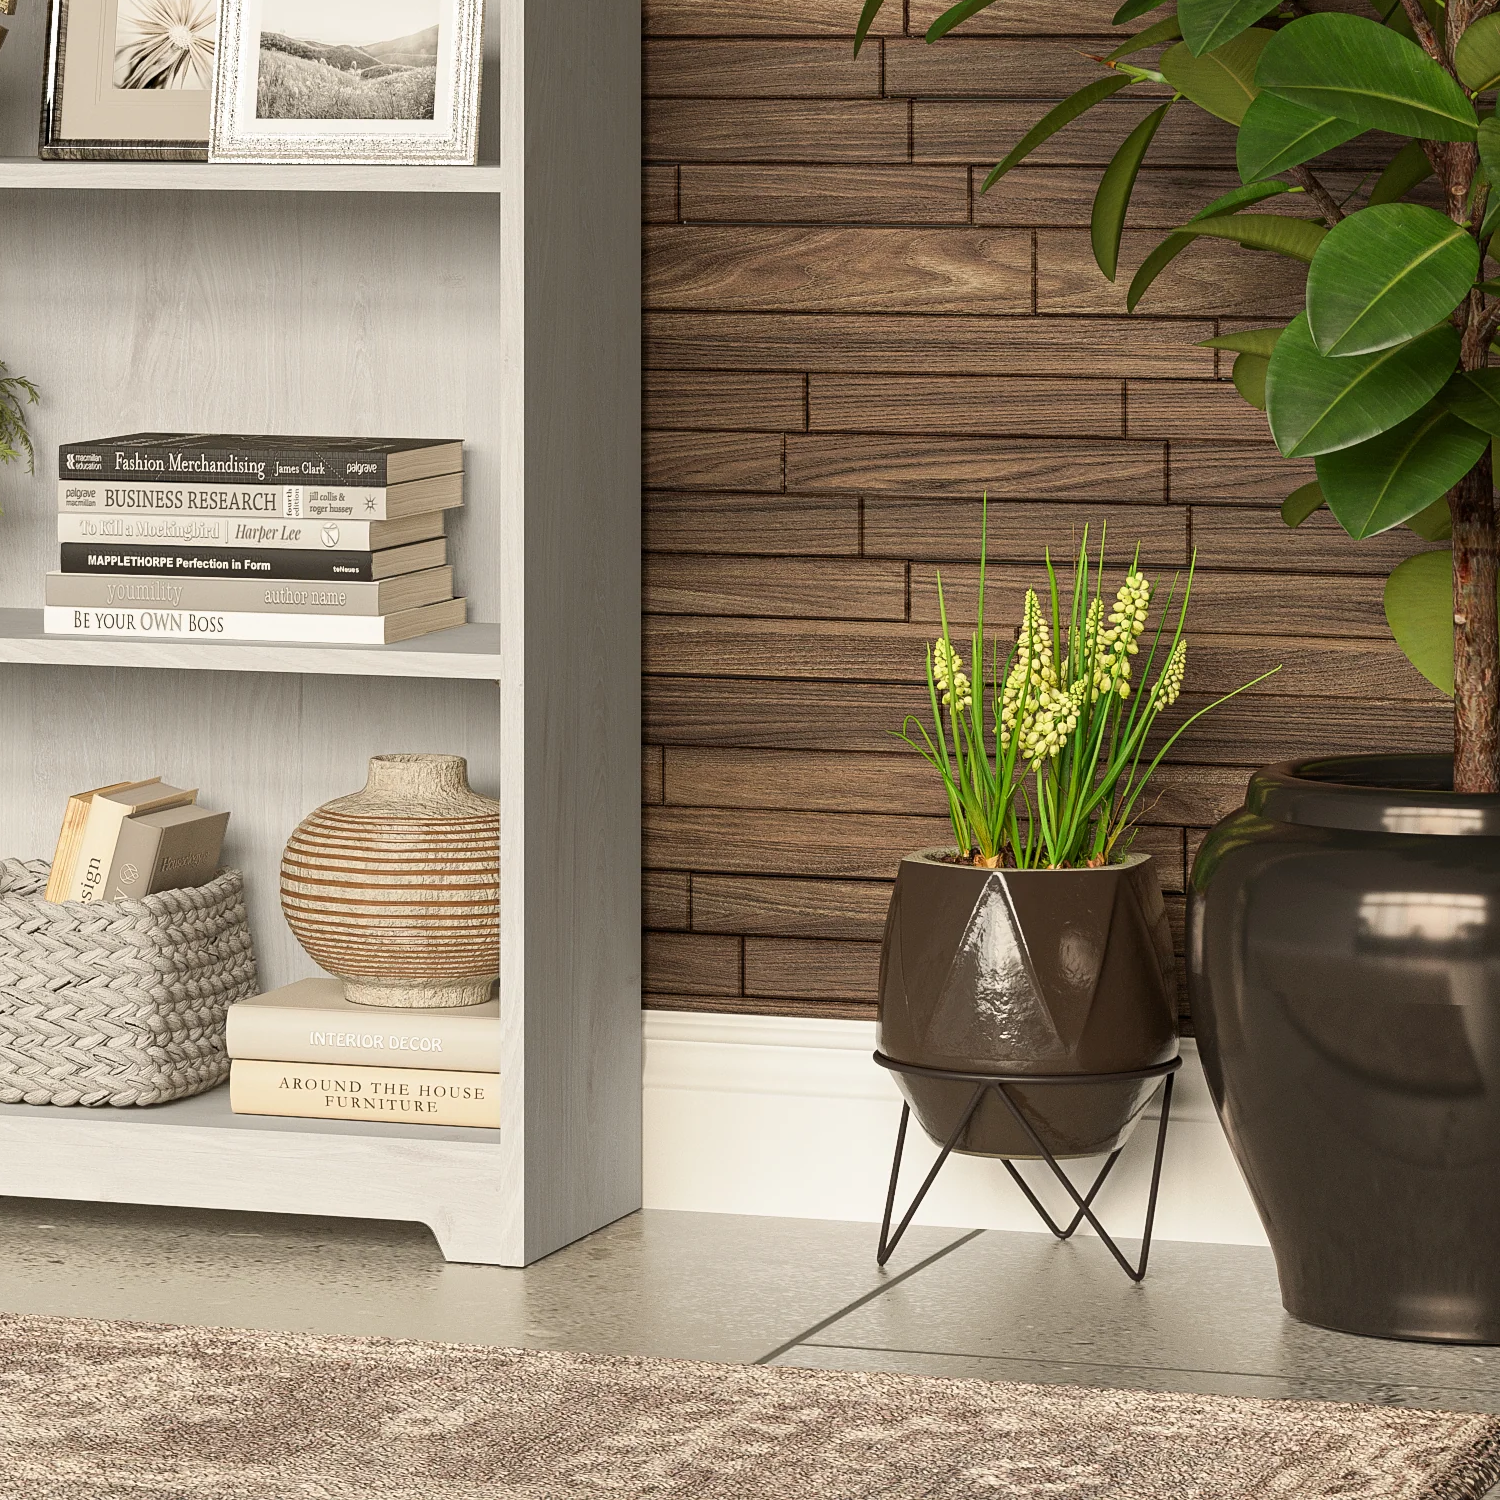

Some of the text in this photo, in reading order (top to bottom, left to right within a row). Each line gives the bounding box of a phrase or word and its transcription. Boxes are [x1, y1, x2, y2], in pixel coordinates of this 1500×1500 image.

[75, 454, 102, 462] macmillan
[75, 461, 102, 470] education
[114, 452, 266, 480] Fashion Merchandising
[274, 461, 326, 476] James Clark
[346, 461, 378, 475] palgrave
[65, 487, 96, 499] palgrave
[65, 498, 96, 507] macmillan
[104, 489, 277, 511] BUSINESS RESEARCH
[309, 492, 346, 503] jill collis &
[309, 504, 353, 515] roger hussey
[80, 520, 220, 541] To Kill a Mockingbird
[234, 523, 302, 543] Harper Lee
[88, 554, 271, 571] MAPPLETHORPE Perfection in Form
[107, 580, 184, 607] youmility
[264, 586, 347, 606] author name
[74, 610, 224, 633] BE YOUR OWN BOSS
[81, 856, 102, 903] sign
[309, 1031, 443, 1052] INTERIOR DECOR
[278, 1076, 485, 1100] AROUND THE HOUSE
[325, 1094, 438, 1113] FURNITURE
